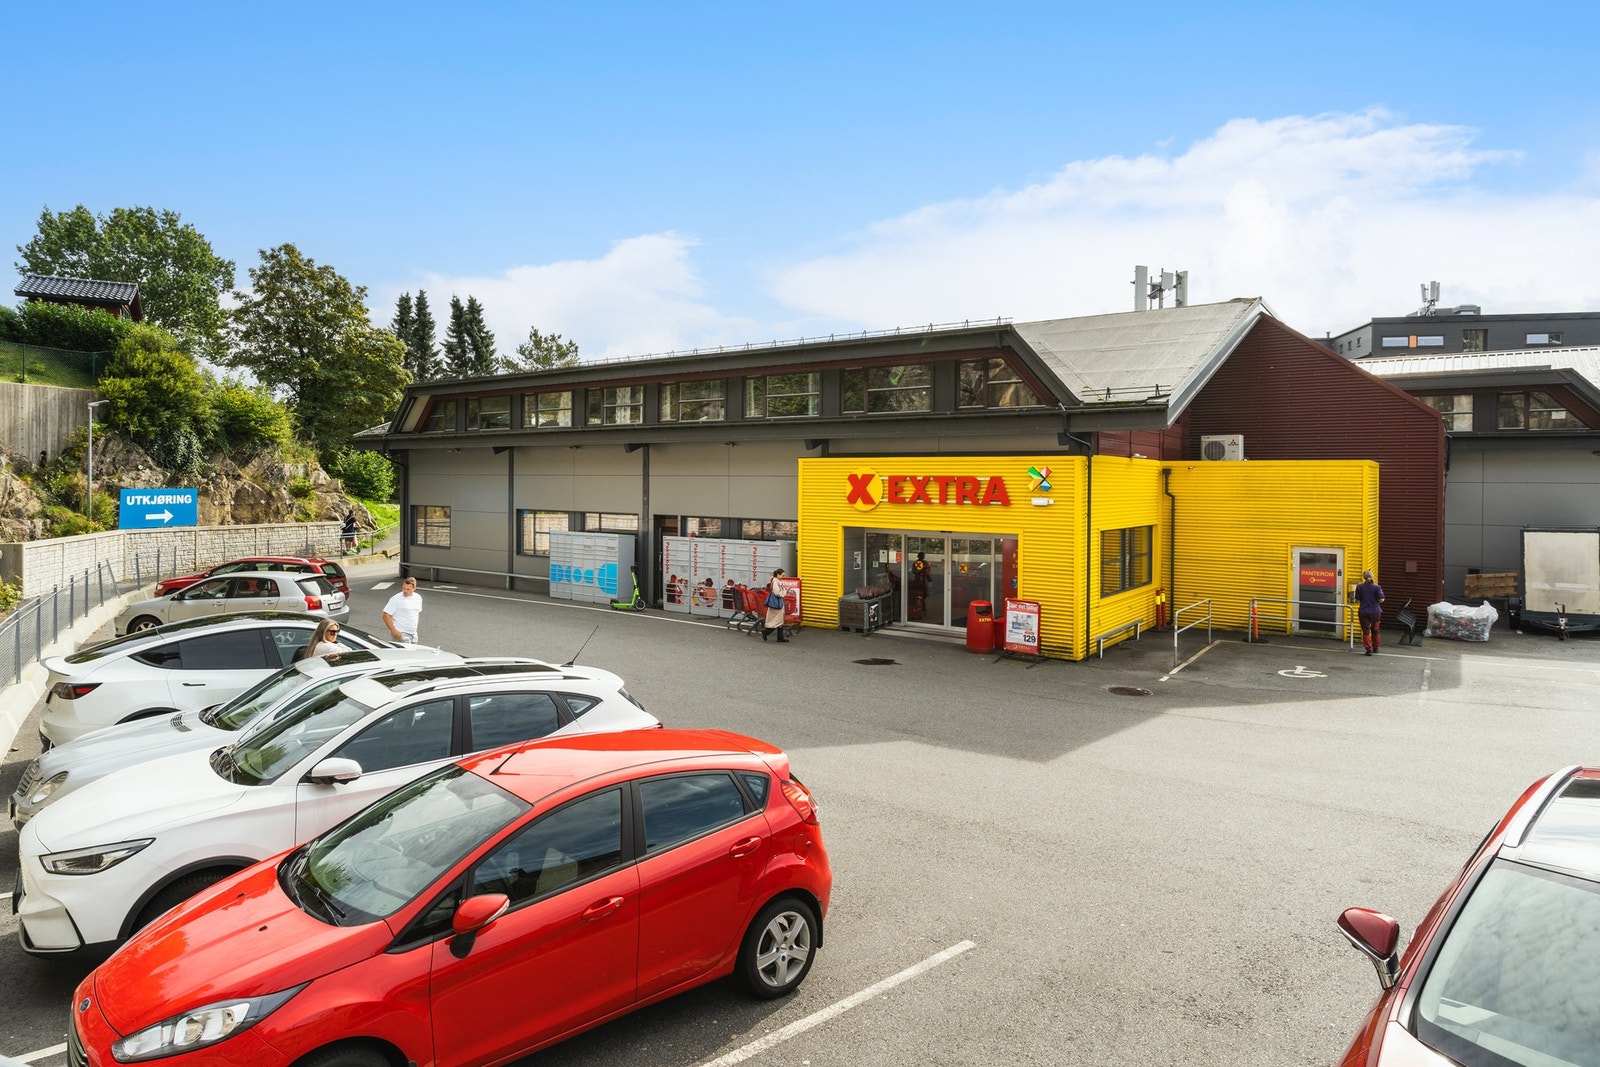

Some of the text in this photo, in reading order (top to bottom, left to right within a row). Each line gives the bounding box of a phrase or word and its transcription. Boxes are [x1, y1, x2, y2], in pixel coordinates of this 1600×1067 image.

[887, 474, 1013, 507] EXTRA
[126, 494, 193, 506] UTKJØRING
[1301, 569, 1335, 577] PANTEROM
[1023, 634, 1036, 643] 129
